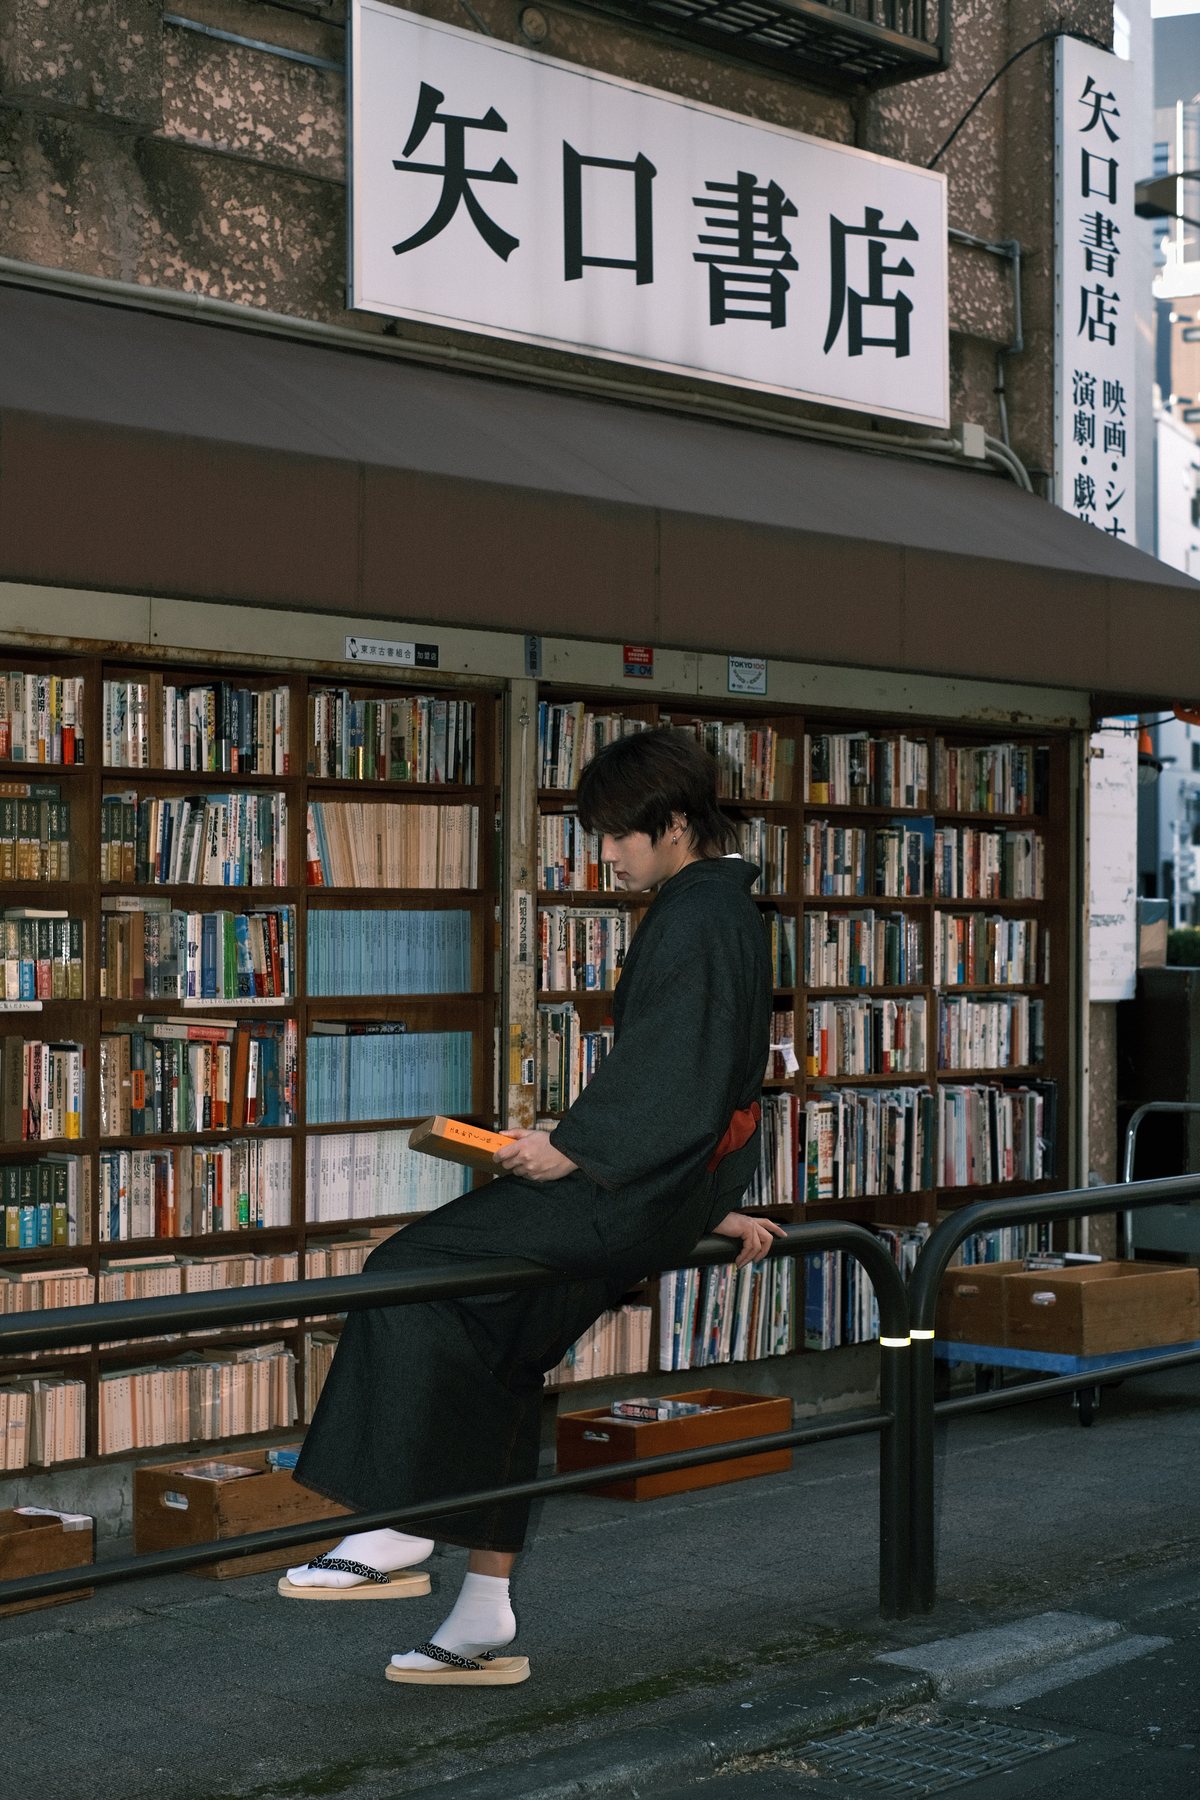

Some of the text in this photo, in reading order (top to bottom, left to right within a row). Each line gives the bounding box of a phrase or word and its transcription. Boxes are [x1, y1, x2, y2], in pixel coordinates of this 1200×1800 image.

[392, 81, 919, 358] 矢口書店
[1078, 75, 1120, 347] 矢口書店
[361, 645, 411, 659] 東京古書組合
[519, 896, 527, 962] 防犯カメラ設置
